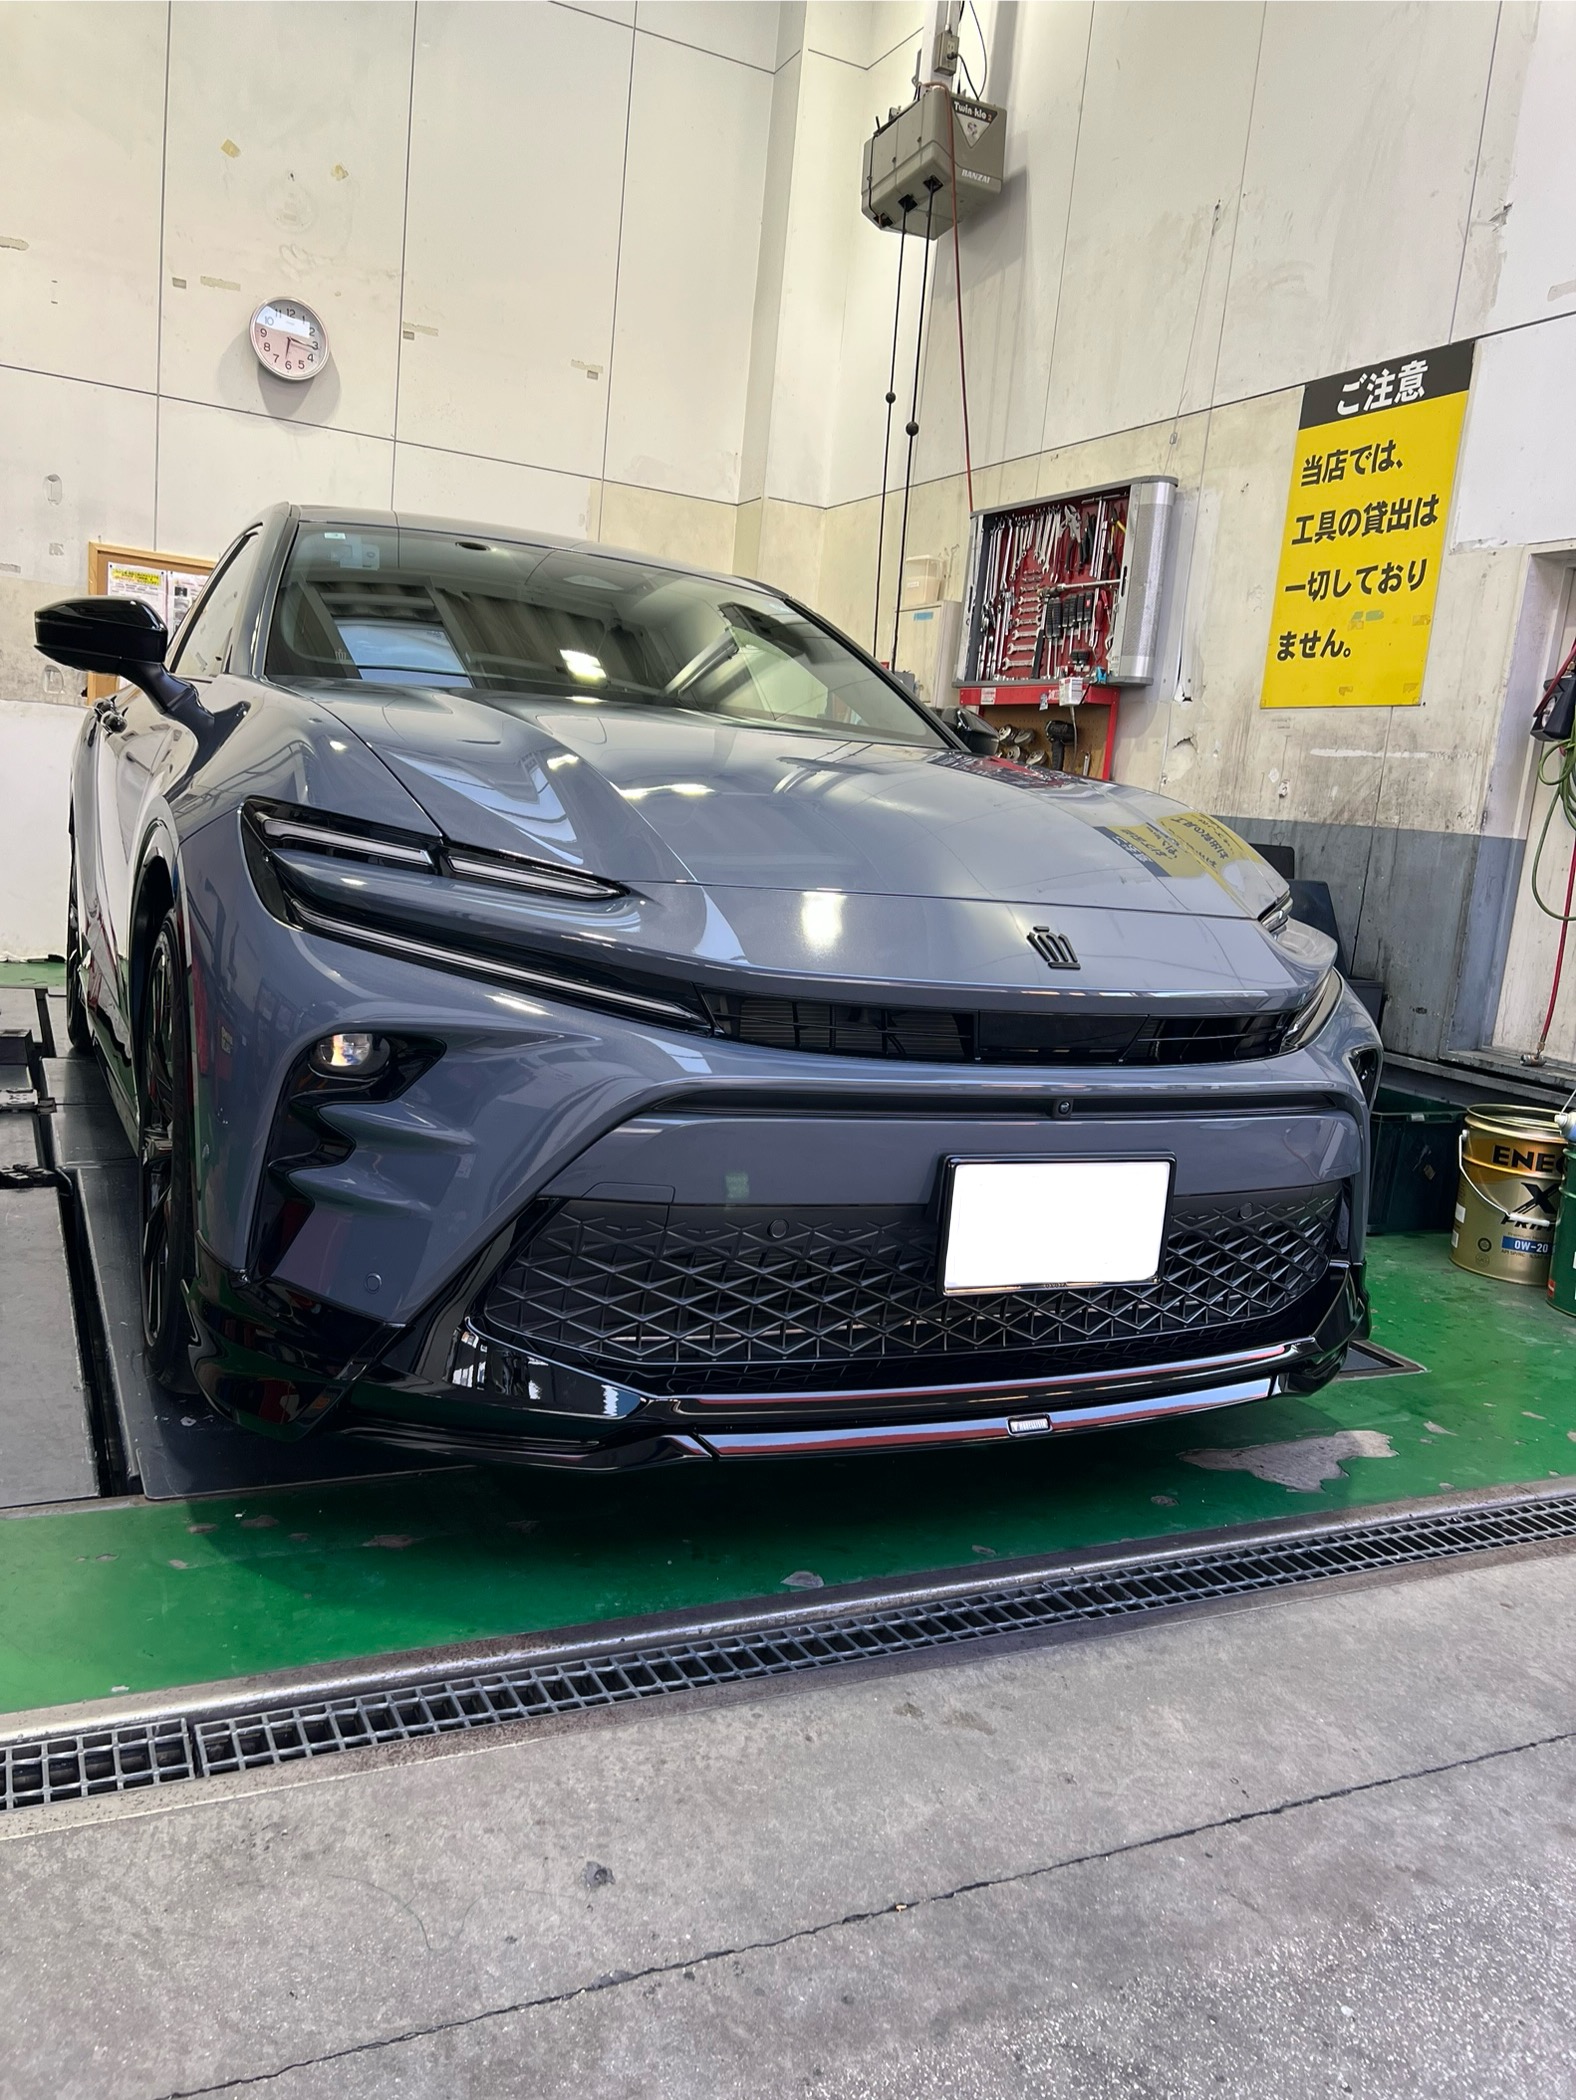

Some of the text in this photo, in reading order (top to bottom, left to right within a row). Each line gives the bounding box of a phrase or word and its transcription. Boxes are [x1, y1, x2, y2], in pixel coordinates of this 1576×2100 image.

[954, 101, 973, 116] Twin
[961, 169, 990, 184] BANZAI
[286, 308, 296, 319] 12
[264, 316, 274, 326] 10
[260, 328, 267, 338] 9
[309, 327, 316, 337] 2
[263, 342, 271, 352] 8
[312, 341, 319, 351] 3
[273, 353, 280, 363] 7
[307, 353, 314, 362] 4
[285, 360, 292, 370] 6
[298, 360, 305, 369] 5
[1337, 359, 1428, 416] ご注意
[1300, 439, 1403, 487] 当店では、
[1291, 494, 1439, 545] 工具の貸出は
[1284, 558, 1427, 602] 一切しており
[1276, 628, 1351, 661] ません。
[1514, 1239, 1549, 1253] 0W-20
